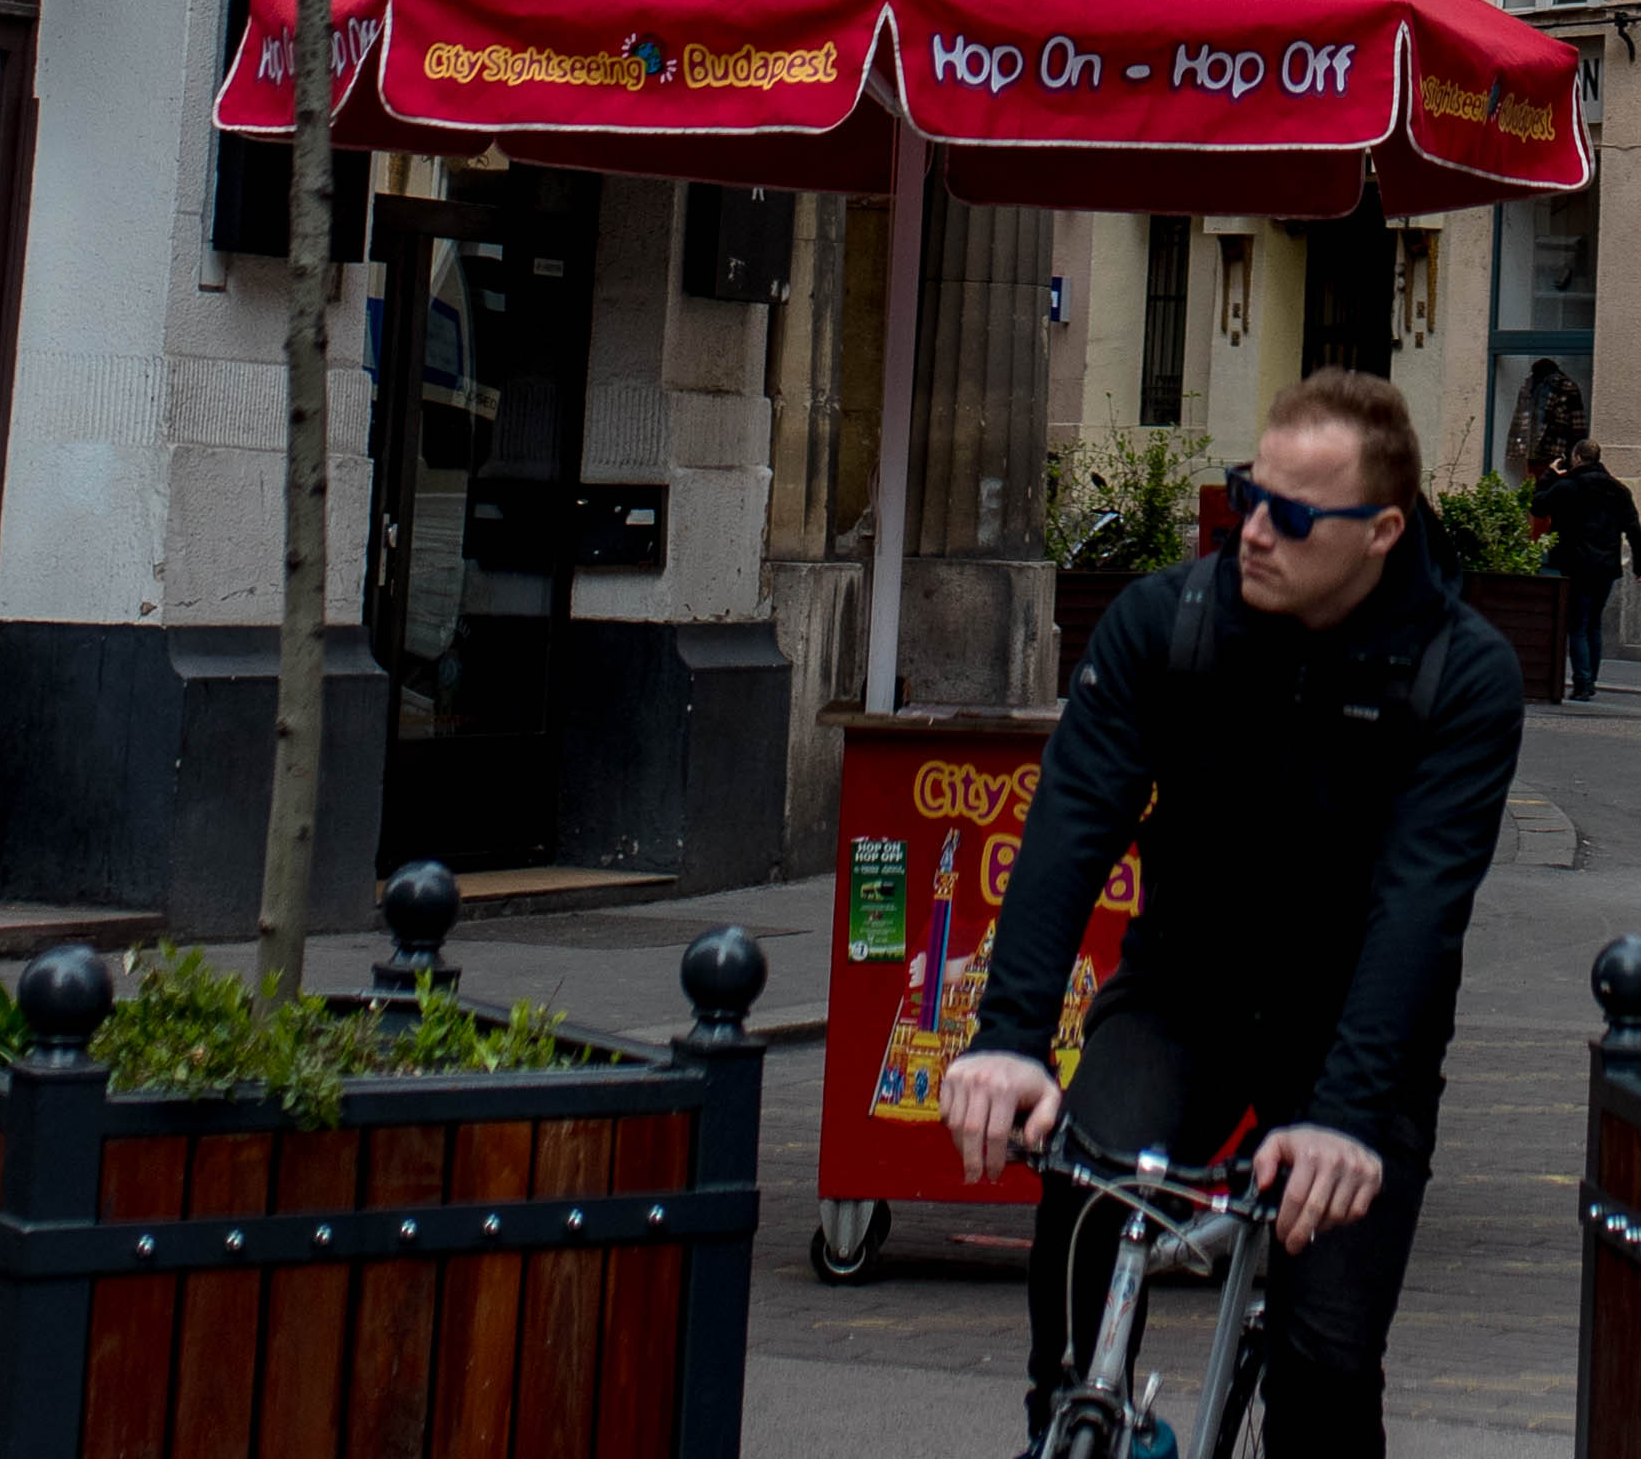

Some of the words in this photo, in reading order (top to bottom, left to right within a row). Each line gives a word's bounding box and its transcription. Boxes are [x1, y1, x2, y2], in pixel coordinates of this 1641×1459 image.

[482, 45, 647, 91] Sightseeing
[683, 41, 838, 90] Budapest
[933, 33, 1023, 93] Hop
[1041, 35, 1101, 88] On
[1174, 43, 1264, 98] Hop
[1281, 40, 1355, 93] Off
[913, 759, 1010, 826] City
